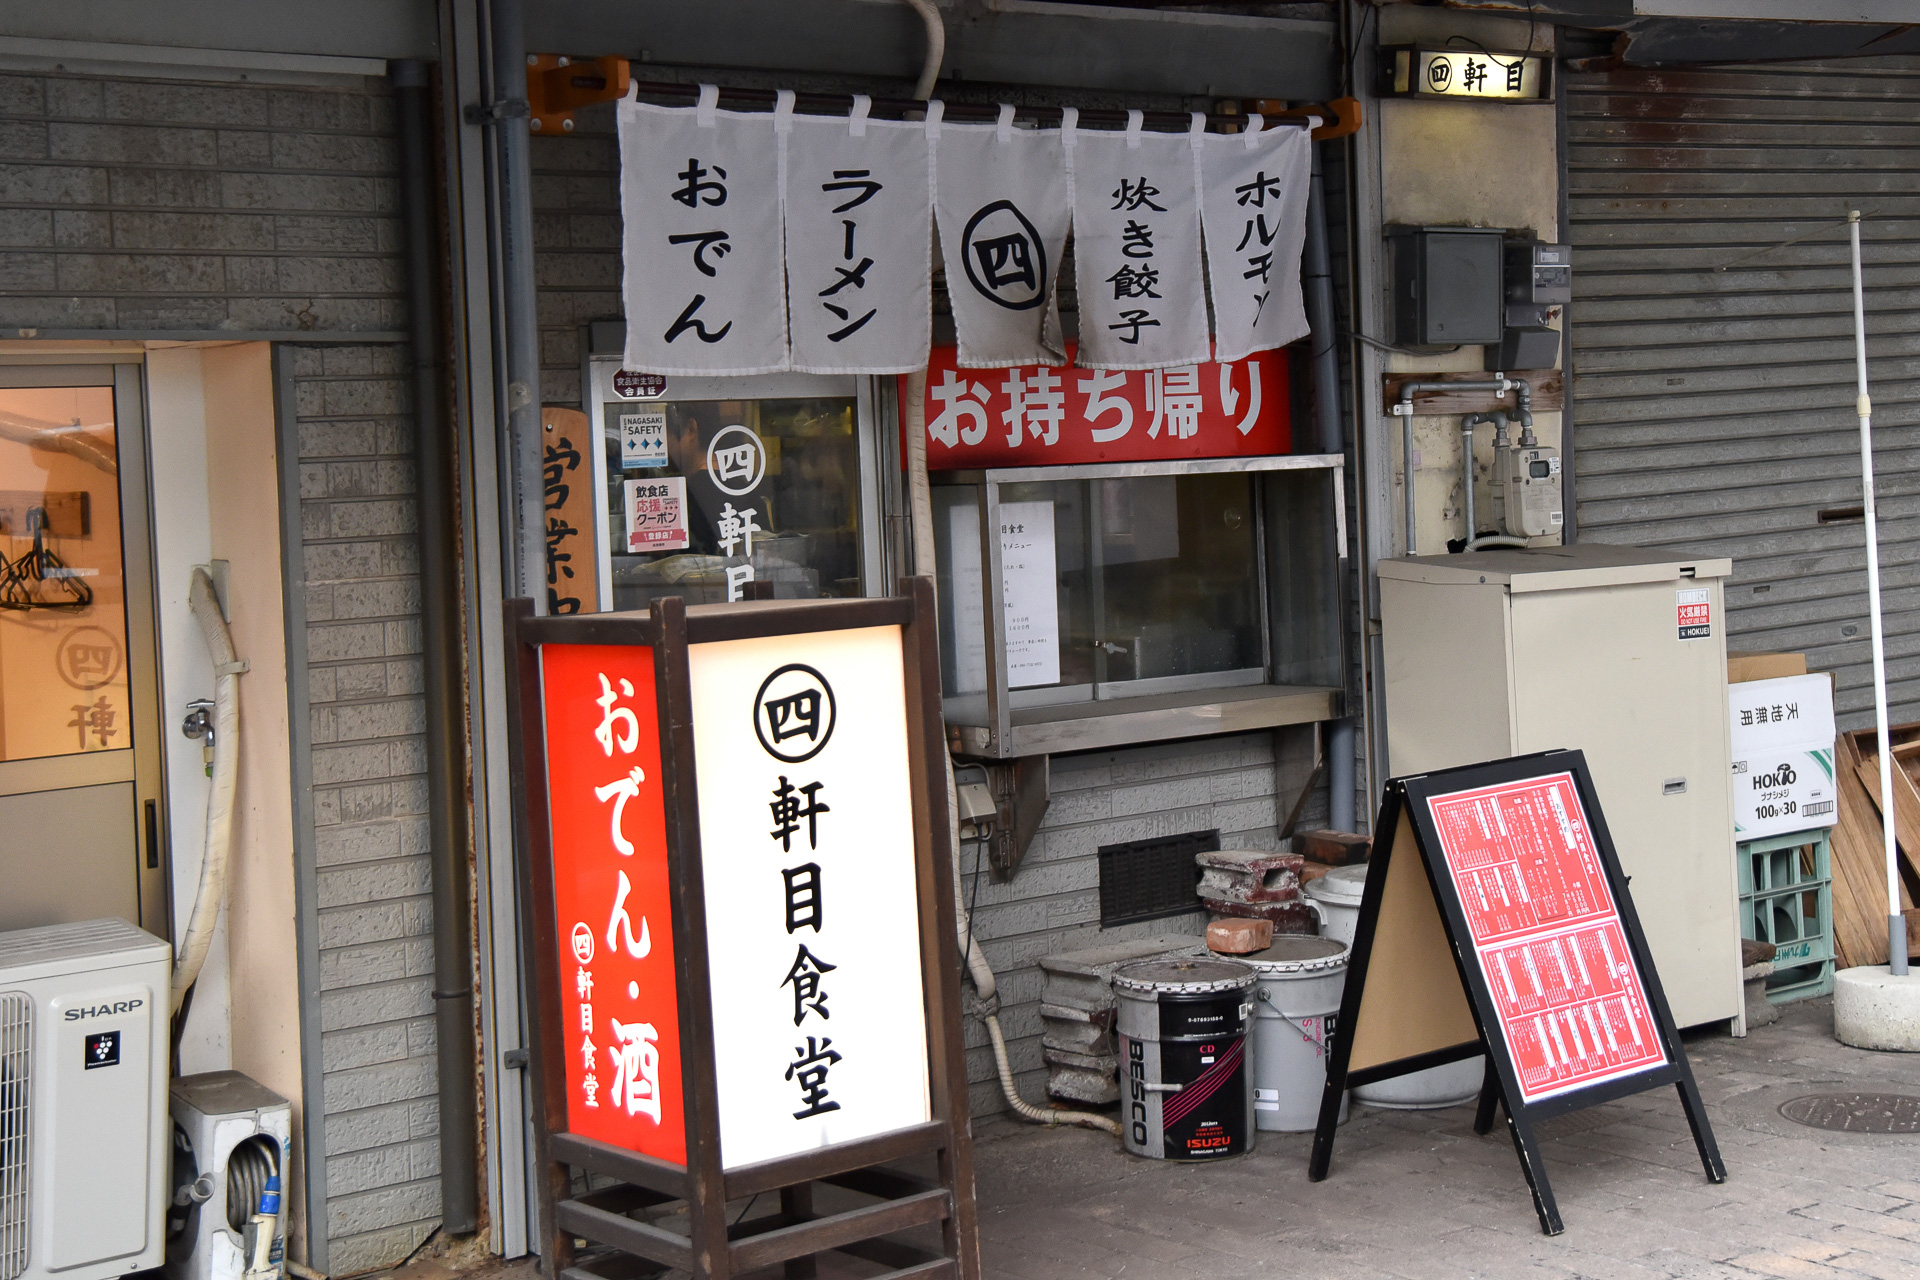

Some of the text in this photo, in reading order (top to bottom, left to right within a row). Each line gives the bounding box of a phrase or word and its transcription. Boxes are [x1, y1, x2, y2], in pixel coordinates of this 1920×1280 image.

[1428, 56, 1523, 92] 四軒目
[664, 158, 732, 343] おでん
[818, 168, 883, 342] ラーメン
[1105, 175, 1168, 345] 炊き餃子
[625, 387, 656, 396] 会員証
[928, 360, 1262, 448] お持ち帰り
[628, 425, 662, 435] SAFETY
[636, 485, 669, 498] 飲食店
[637, 499, 661, 513] 応援
[637, 512, 677, 525] クーポン
[1679, 605, 1708, 619] 火気厳禁
[1687, 627, 1710, 636] HOKUEI
[1740, 702, 1799, 726] 天地無用
[1761, 789, 1789, 801] ブナシメジ
[594, 672, 663, 1126] おでん・酒
[753, 663, 843, 1120] 四軒目食堂
[64, 999, 144, 1021] SHARP
[571, 921, 600, 1109] 四軒目食堂
[1199, 1044, 1215, 1053] CD
[1129, 1039, 1148, 1147] BESCO
[1187, 1136, 1231, 1148] ISUZU
